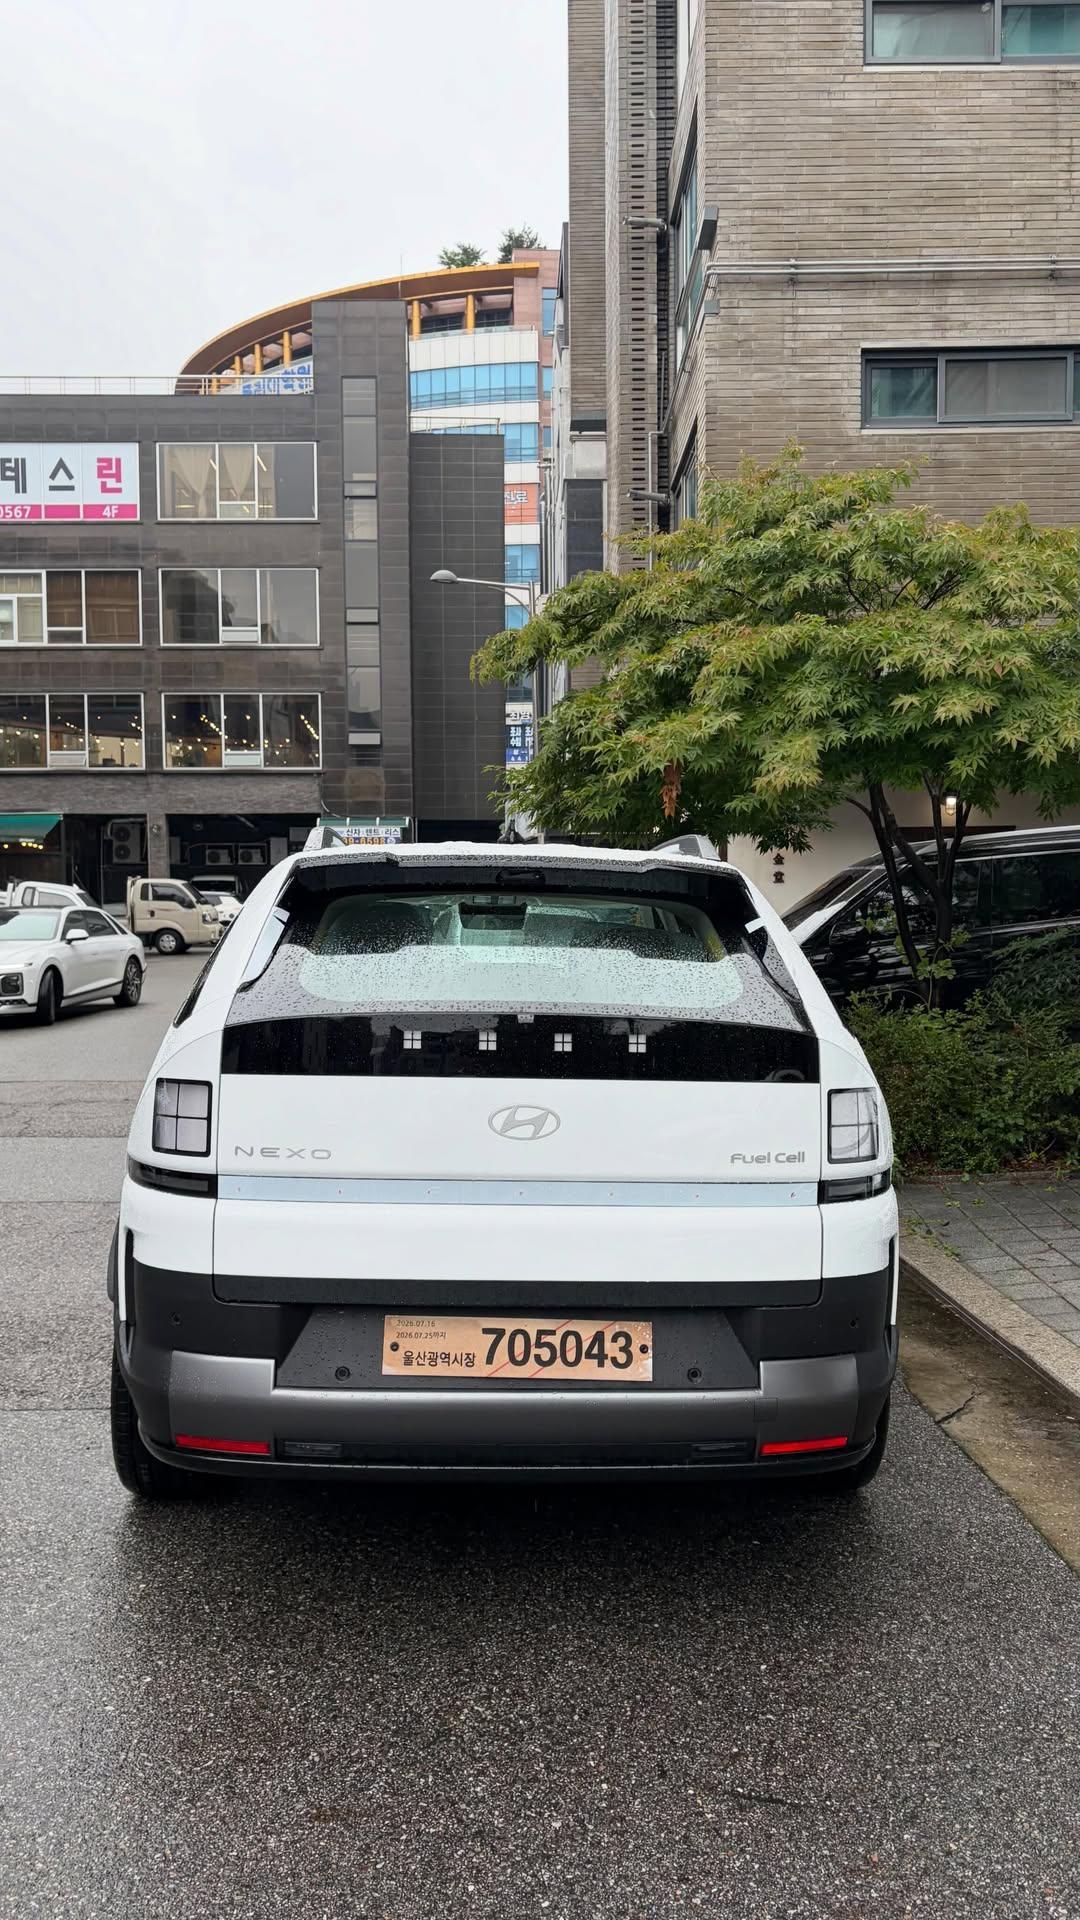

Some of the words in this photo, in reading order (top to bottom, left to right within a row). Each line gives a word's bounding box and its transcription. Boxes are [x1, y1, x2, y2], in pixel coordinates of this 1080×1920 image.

[0, 457, 123, 494] 테스린
[102, 505, 119, 518] 4F
[346, 827, 361, 837] 신차
[384, 827, 400, 837] 리스
[234, 1145, 332, 1160] NEXO
[730, 1151, 771, 1164] Fuel
[774, 1151, 805, 1163] Cell
[481, 1327, 634, 1370] 705043
[402, 1350, 477, 1368] 울산광역시장
